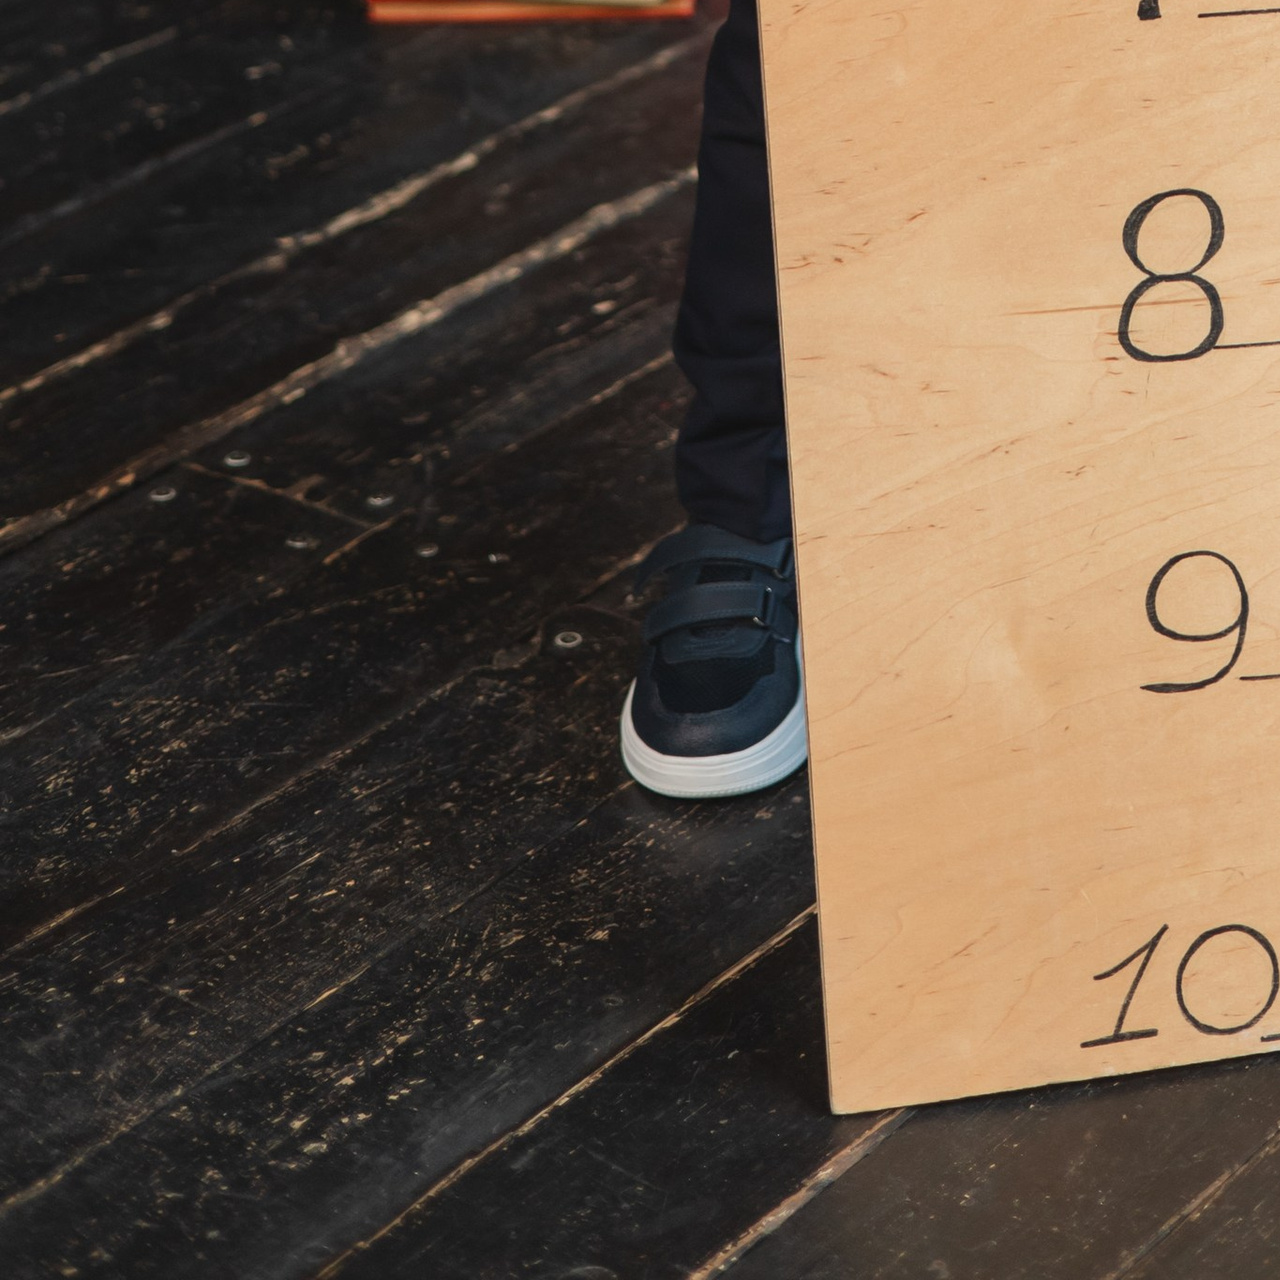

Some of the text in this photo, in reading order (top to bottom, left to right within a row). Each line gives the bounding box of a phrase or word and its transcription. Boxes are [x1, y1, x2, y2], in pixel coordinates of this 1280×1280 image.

[1117, 188, 1226, 363] 8
[1139, 550, 1250, 694] 9
[1080, 923, 1280, 1049] 10
